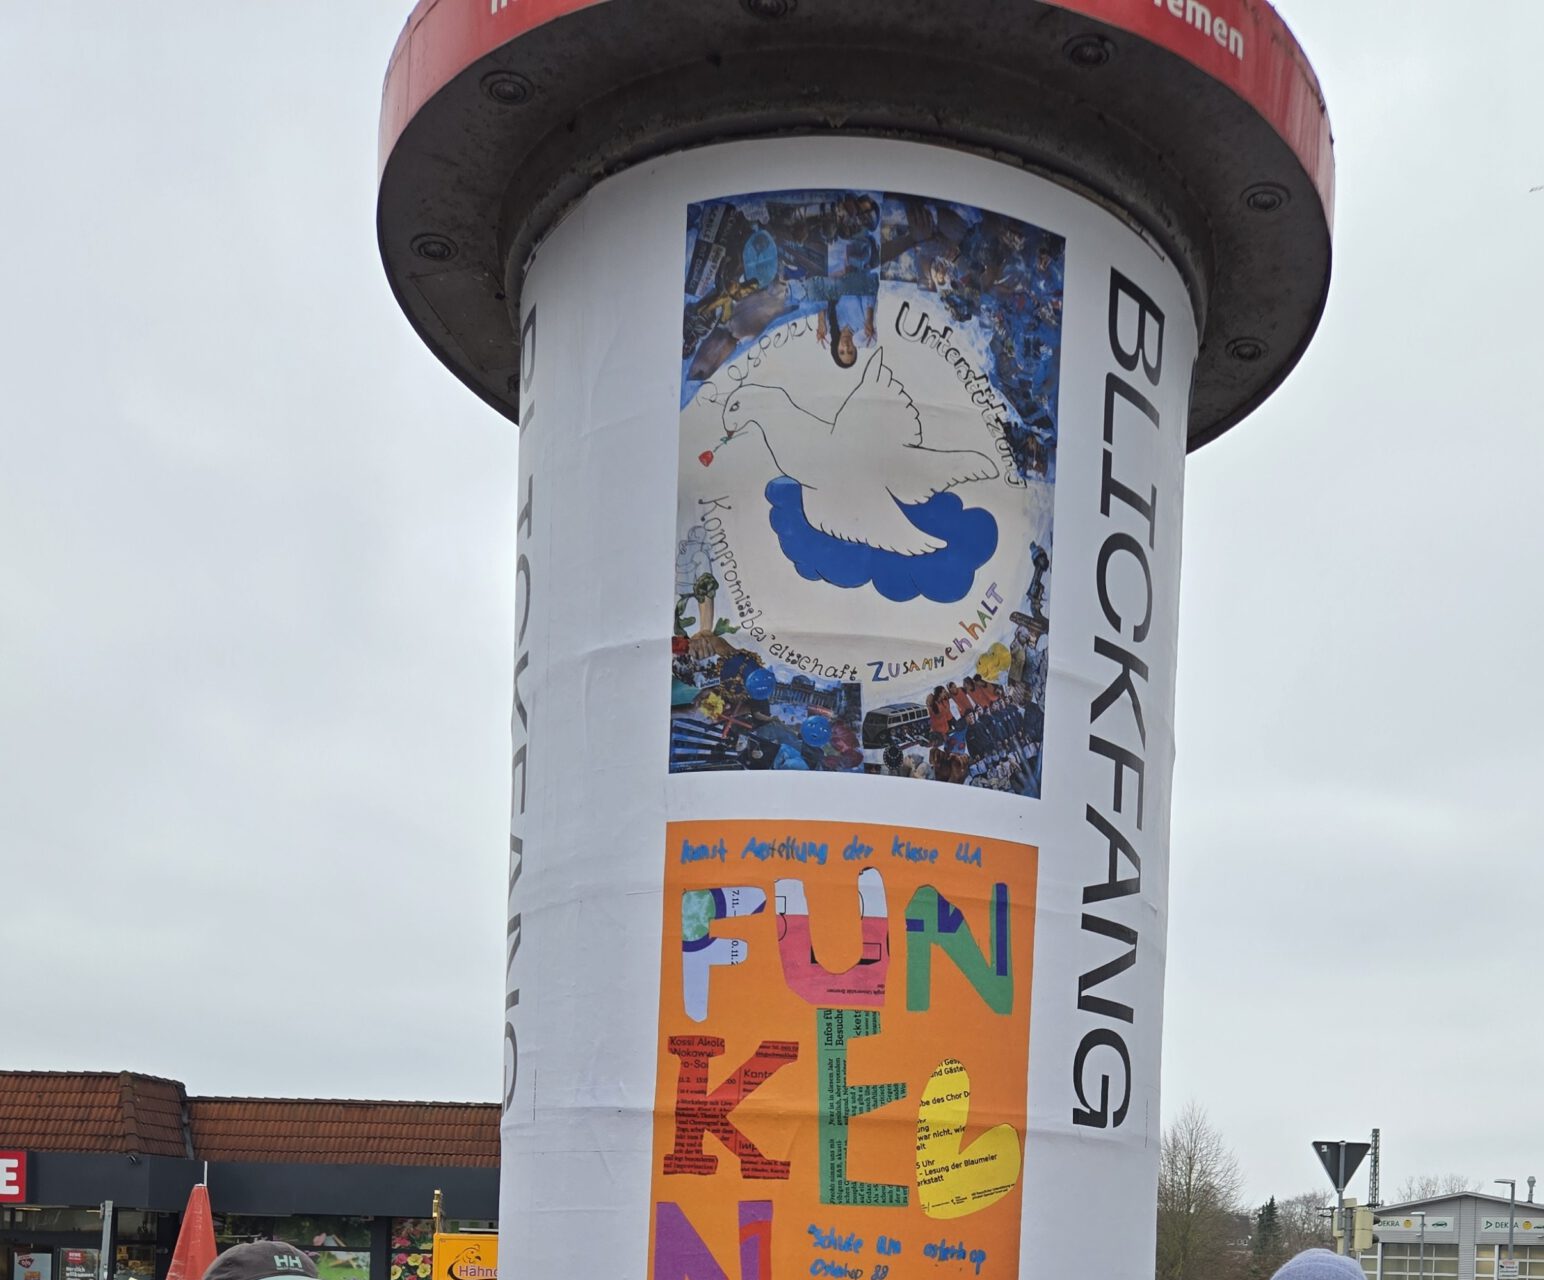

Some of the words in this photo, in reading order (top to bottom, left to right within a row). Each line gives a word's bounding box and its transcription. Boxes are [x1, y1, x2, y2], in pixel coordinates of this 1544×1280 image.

[1072, 266, 1166, 1128] BLICKFANG
[823, 1022, 833, 1047] Infos
[932, 1096, 945, 1105] des
[946, 1092, 962, 1102] Chor
[922, 1159, 935, 1168] Uhr
[924, 1165, 950, 1177] Lesung
[1494, 1221, 1520, 1229] DEKA
[273, 1254, 303, 1269] HH
